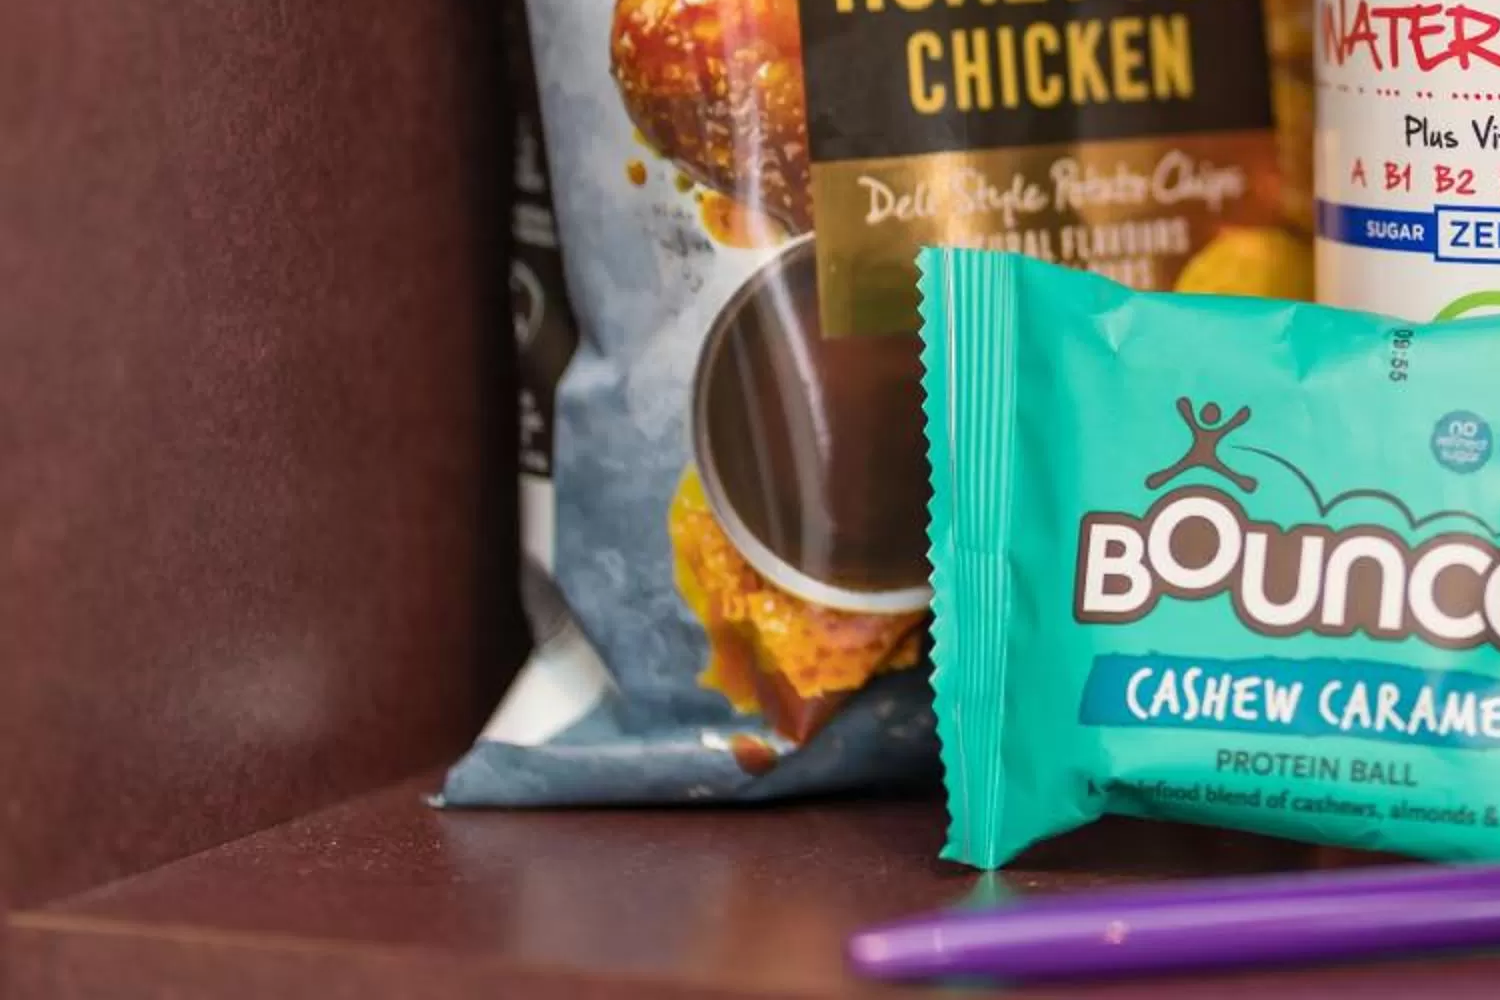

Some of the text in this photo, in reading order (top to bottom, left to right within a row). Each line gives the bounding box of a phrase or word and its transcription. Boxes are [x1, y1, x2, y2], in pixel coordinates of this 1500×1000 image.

[906, 13, 1194, 116] CHICKEN
[1404, 114, 1459, 150] Plus
[1351, 157, 1368, 188] A
[1385, 161, 1413, 192] B1
[1434, 163, 1475, 196] B2
[1365, 217, 1425, 242] SUGAR
[1125, 666, 1304, 726] CASHEW
[1215, 748, 1419, 788] PROTEIN BALL
[1205, 784, 1261, 808] blend
[1266, 789, 1290, 810] of
[1390, 800, 1476, 827] almonds
[1480, 804, 1499, 829] &
